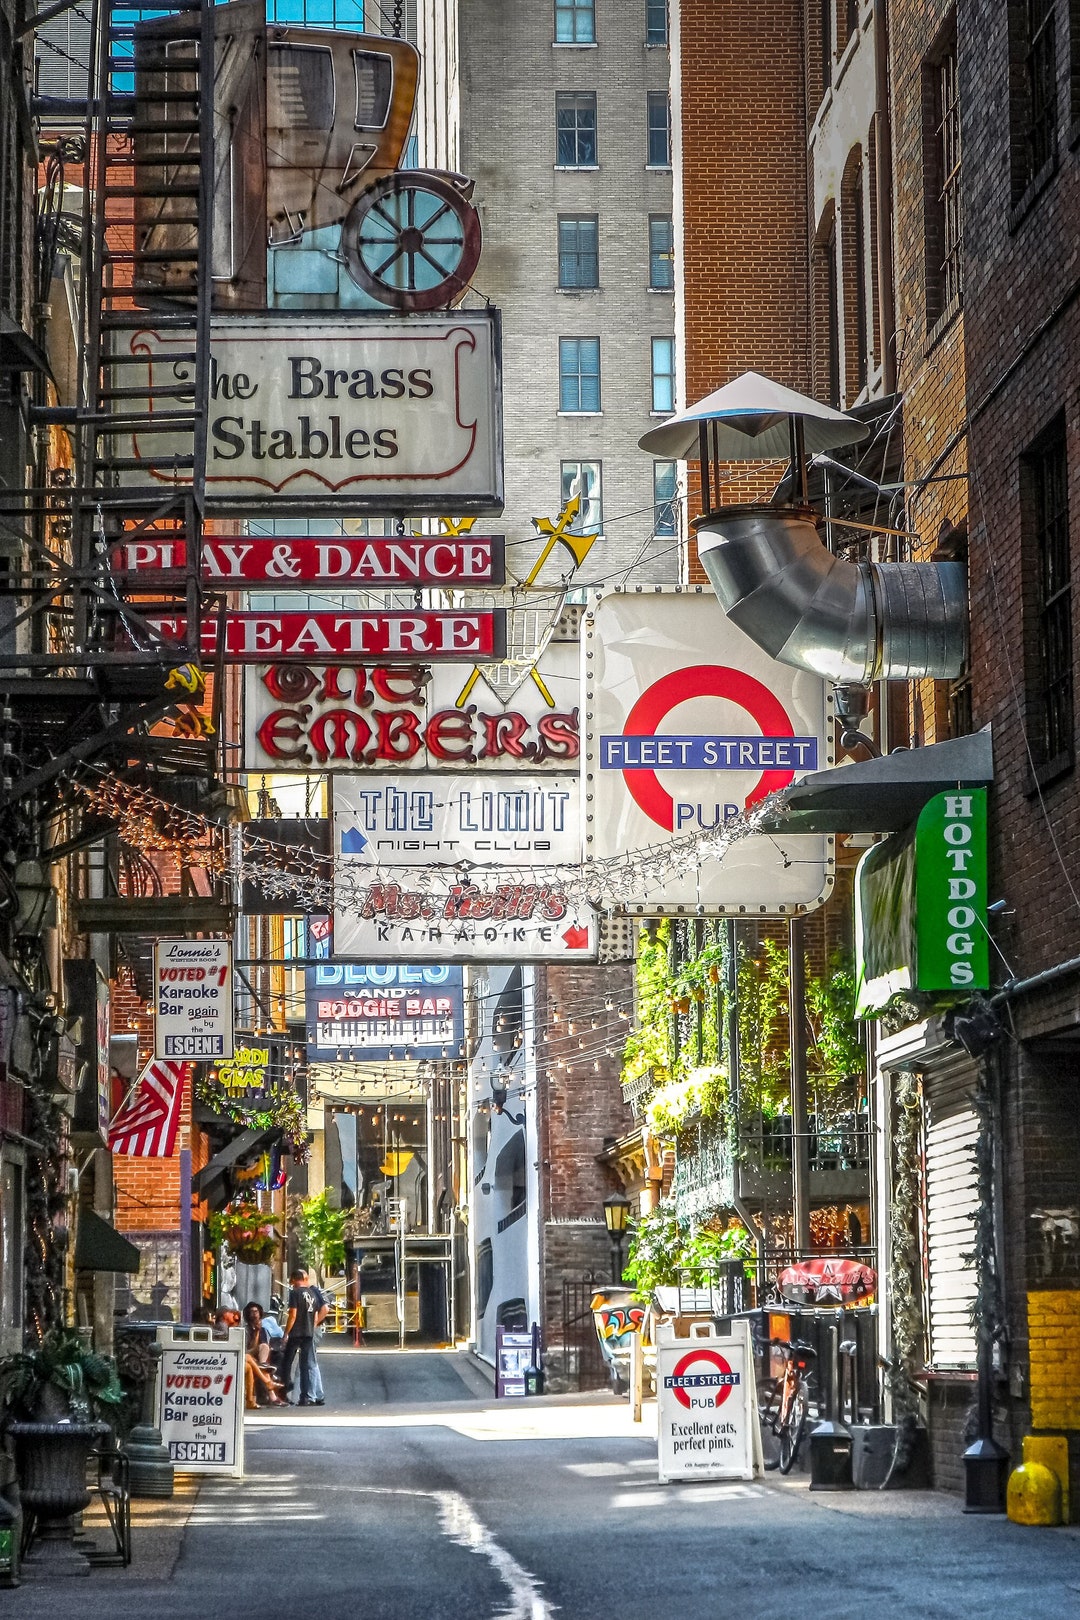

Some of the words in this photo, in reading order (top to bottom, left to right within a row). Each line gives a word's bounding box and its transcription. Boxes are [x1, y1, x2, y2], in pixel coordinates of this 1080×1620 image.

[288, 356, 434, 399] Brass
[212, 416, 399, 460] Stables
[265, 544, 301, 577] &
[315, 544, 492, 577] DANCE
[256, 703, 580, 764] EMBERS
[607, 741, 692, 765] FLEET
[703, 741, 812, 766] STREET
[677, 803, 739, 830] PUB
[377, 840, 459, 850] NIGHT
[474, 840, 551, 850] CLUB
[377, 927, 552, 942] KARAOKE
[166, 944, 221, 958] Lonnie's
[159, 966, 206, 982] VOTED
[159, 984, 219, 999] Karaoke
[357, 988, 408, 999] AND
[159, 1002, 184, 1016] Bar
[188, 1006, 219, 1020] again
[318, 1000, 401, 1018] BOOGIE
[406, 998, 452, 1016] BAR
[203, 1020, 214, 1029] by
[174, 1036, 220, 1055] SCENE
[173, 1352, 227, 1366] Lonnie's
[166, 1374, 212, 1389] VOTED
[666, 1376, 696, 1387] FLEET
[699, 1375, 737, 1386] STREET
[165, 1392, 223, 1406] Karaoke
[691, 1398, 715, 1409] PUB
[164, 1408, 188, 1421] Bar
[192, 1413, 222, 1427] again
[207, 1427, 217, 1436] by
[671, 1422, 713, 1437] Excellent
[716, 1422, 737, 1436] eats,
[177, 1442, 222, 1461] SCENE
[673, 1436, 705, 1454] perfect
[708, 1435, 734, 1453] pints.
